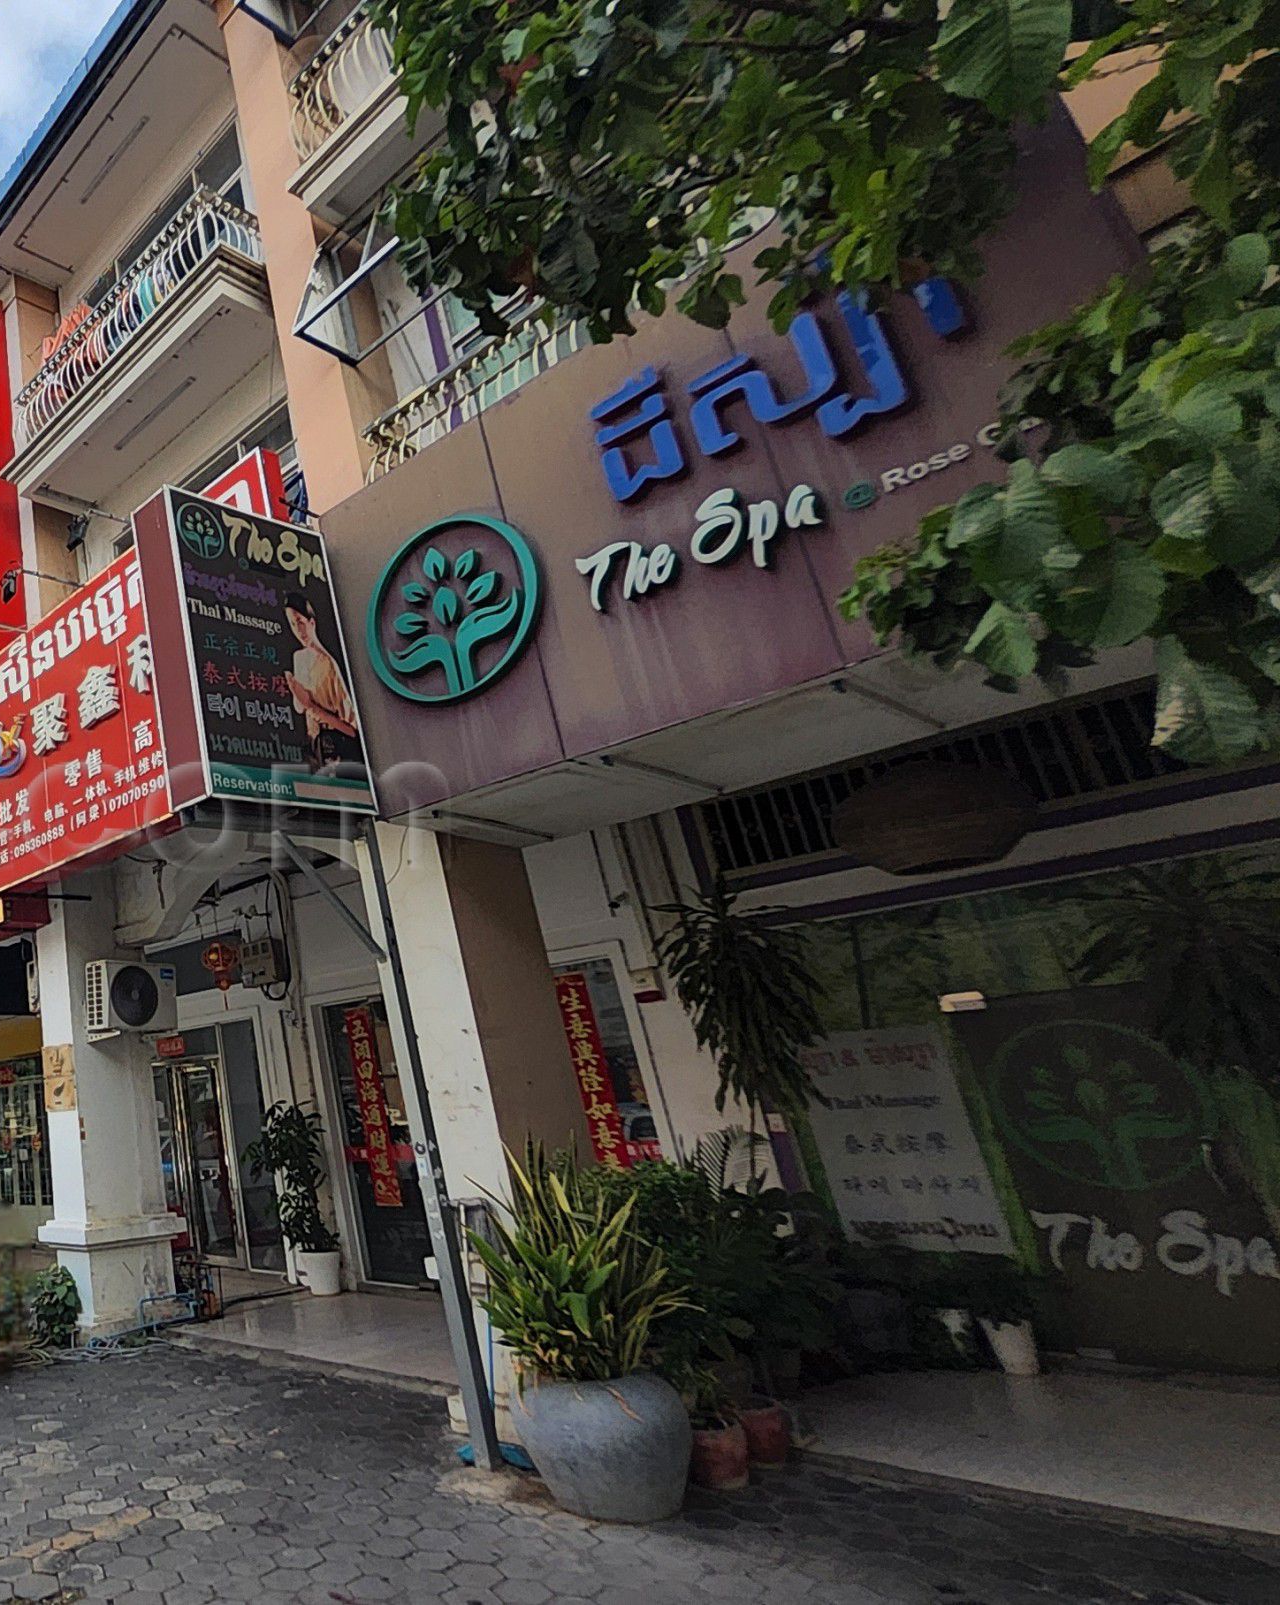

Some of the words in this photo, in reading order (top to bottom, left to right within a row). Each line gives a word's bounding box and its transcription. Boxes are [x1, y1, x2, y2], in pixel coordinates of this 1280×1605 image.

[221, 511, 274, 565] The
[575, 540, 676, 612] The
[691, 484, 821, 568] Spa
[882, 440, 971, 492] Rose
[187, 597, 223, 622] Thai
[224, 606, 283, 634] Massage
[202, 660, 291, 698] 泰式按摩
[206, 692, 243, 723] 타이
[246, 701, 295, 731] 마사지
[64, 748, 104, 788] 零售
[132, 718, 154, 754] 高
[213, 773, 293, 797] Reservation:
[1030, 1208, 1144, 1273] The
[1156, 1208, 1280, 1298] Spa
